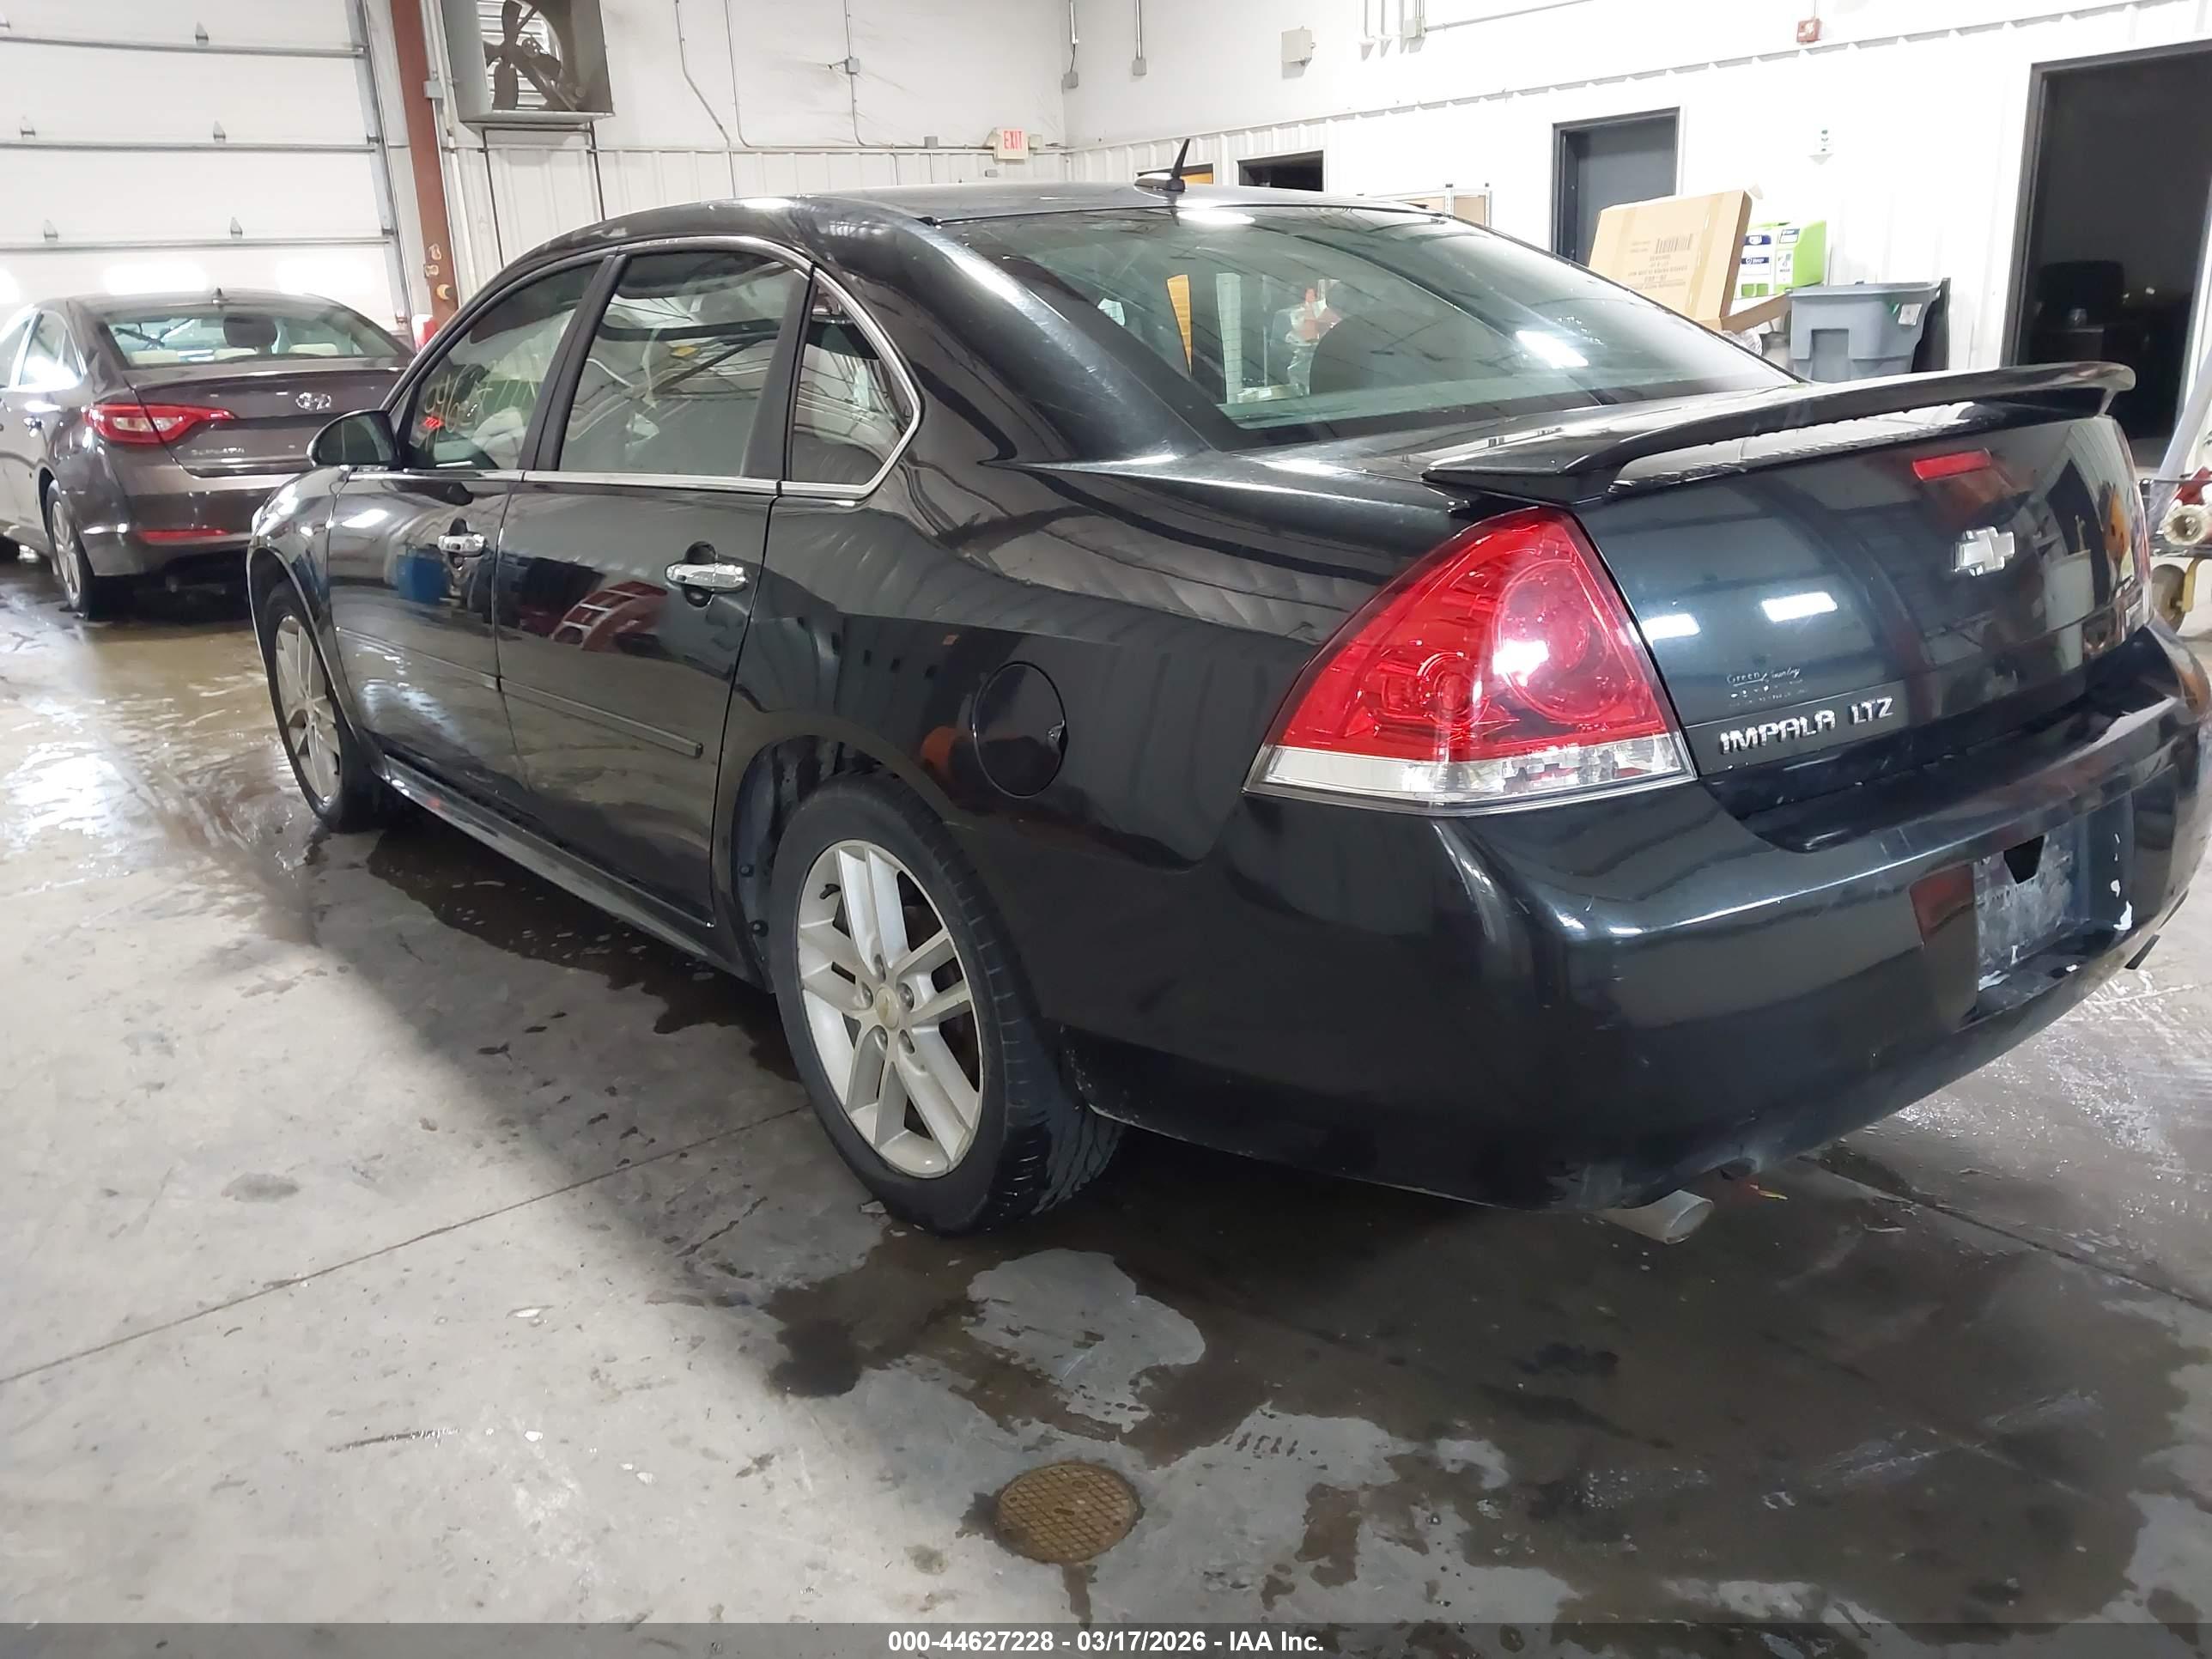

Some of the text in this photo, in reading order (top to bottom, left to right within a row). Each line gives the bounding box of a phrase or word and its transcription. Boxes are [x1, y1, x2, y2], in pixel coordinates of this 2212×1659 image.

[1004, 130, 1024, 150] EXIT
[1719, 709, 1837, 755] IMPALA
[1849, 696, 1894, 726] LTZ
